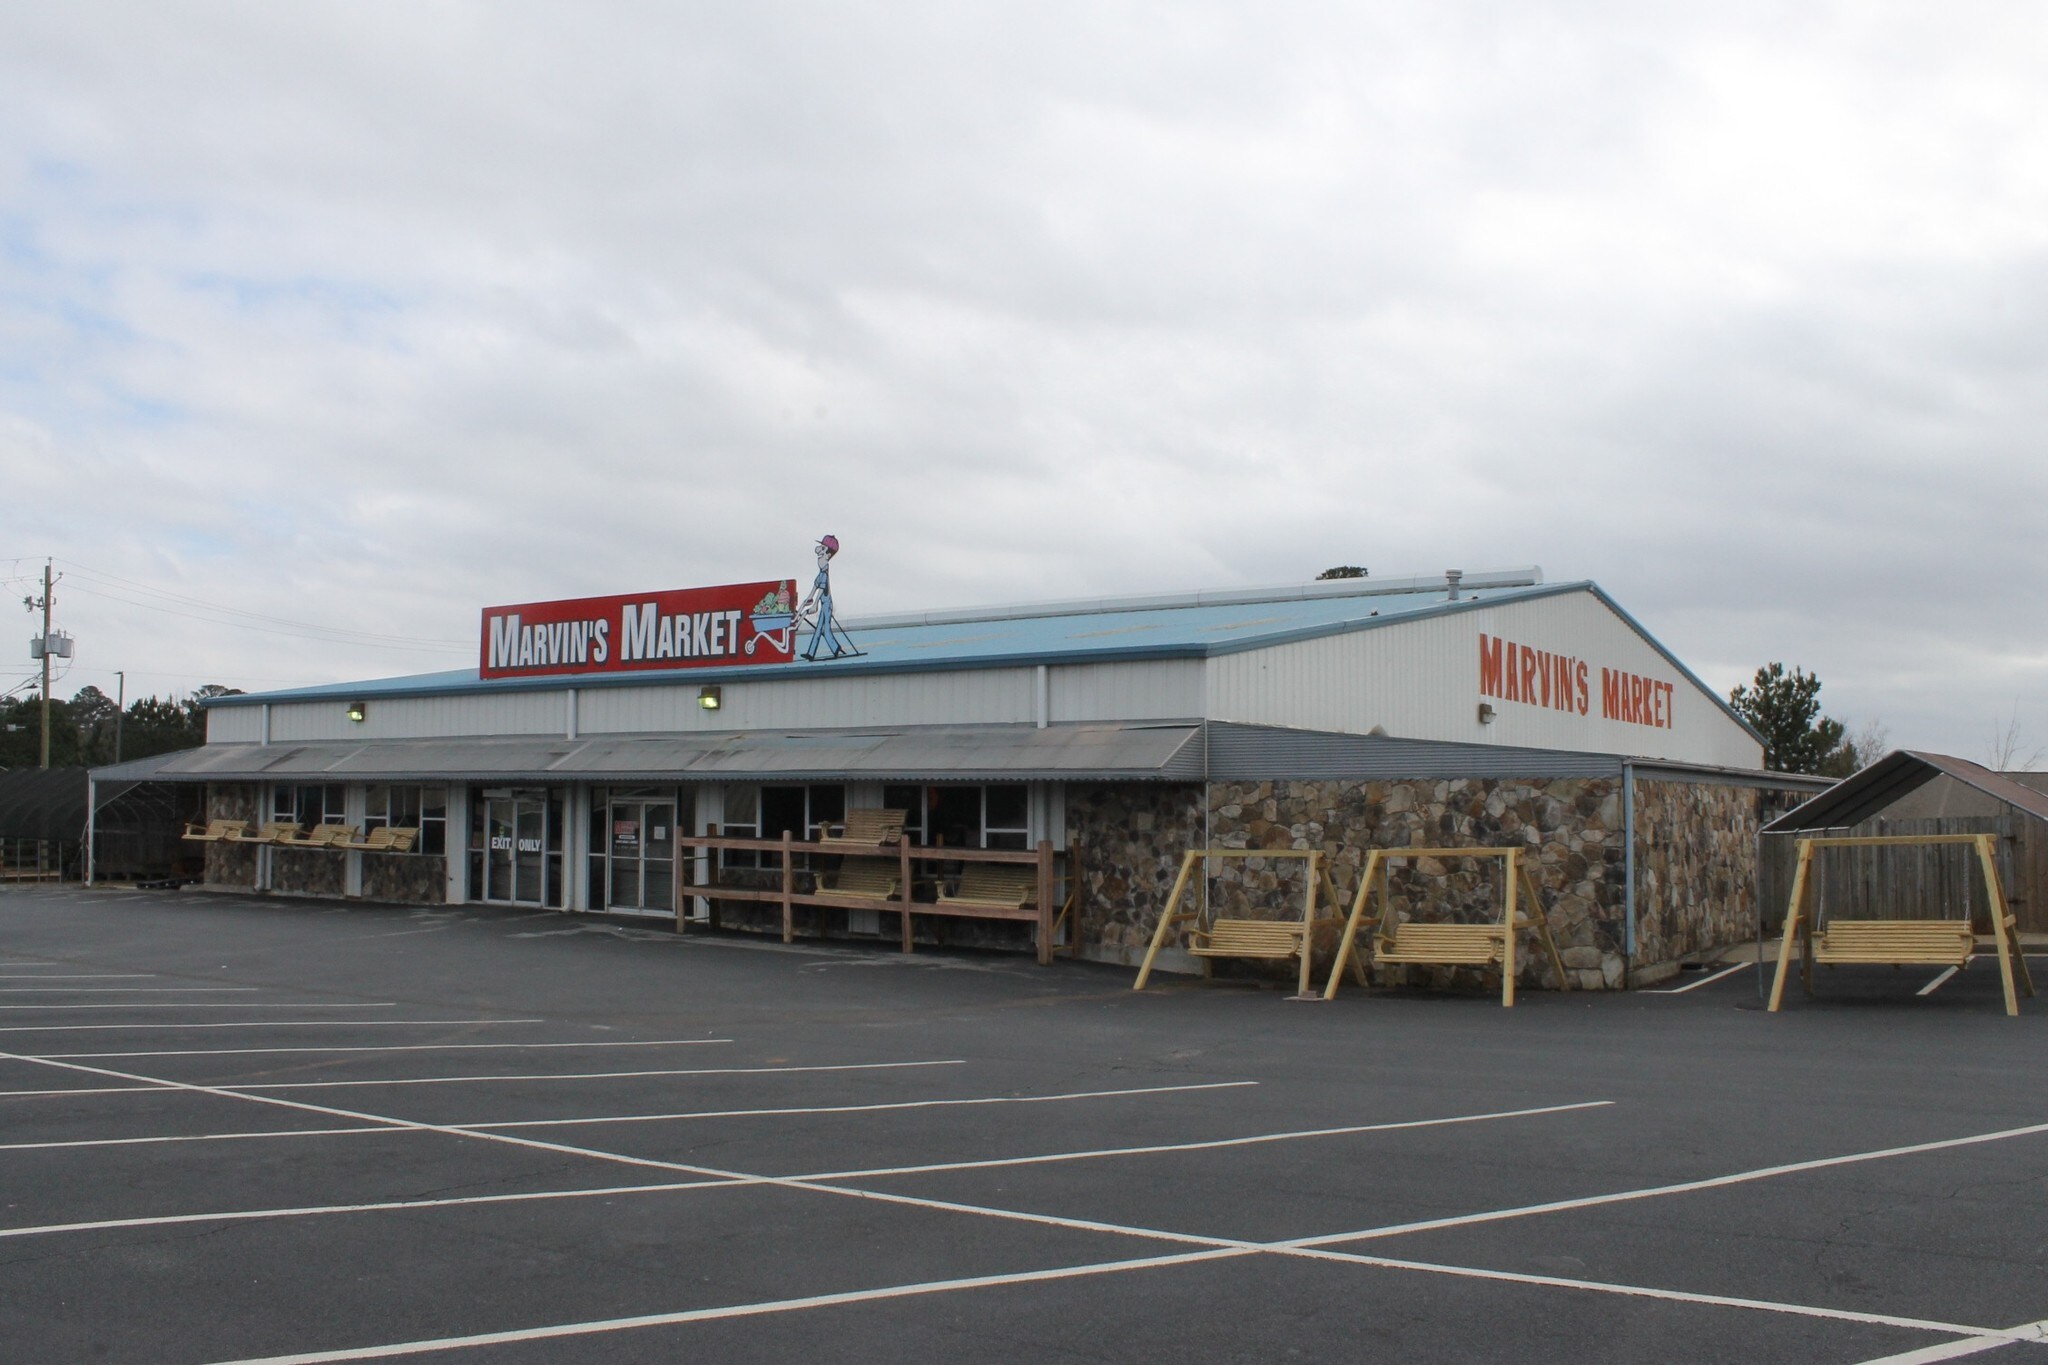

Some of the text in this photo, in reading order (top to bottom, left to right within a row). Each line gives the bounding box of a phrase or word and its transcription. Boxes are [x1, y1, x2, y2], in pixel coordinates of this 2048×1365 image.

[488, 602, 742, 669] MARVIN'S MARKET
[1479, 633, 1673, 729] MARVIN'S MARKET
[491, 836, 541, 852] EXIT ONLY
